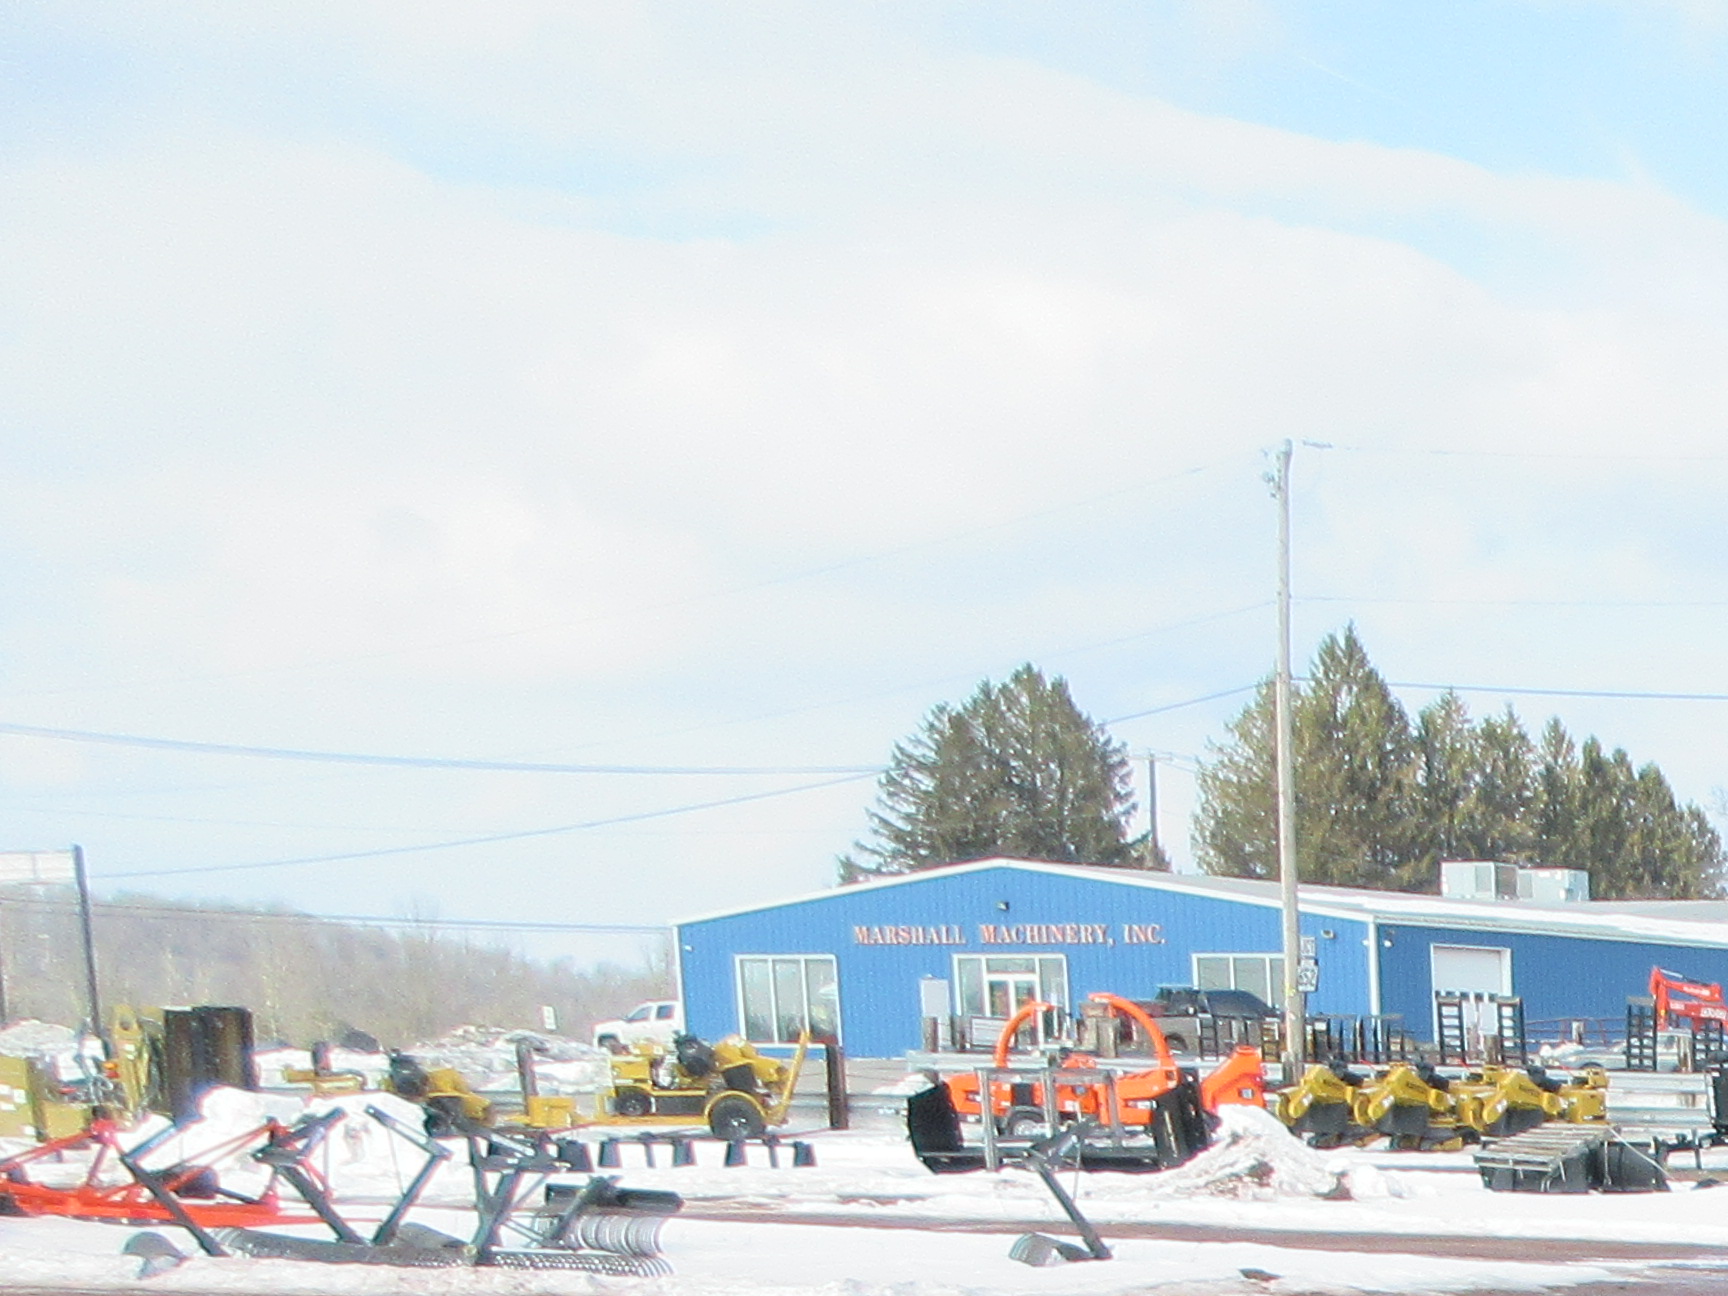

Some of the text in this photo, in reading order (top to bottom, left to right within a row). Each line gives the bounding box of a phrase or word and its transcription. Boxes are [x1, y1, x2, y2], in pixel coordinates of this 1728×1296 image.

[853, 923, 1167, 948] MARSHALL MACHINERY, INC.
